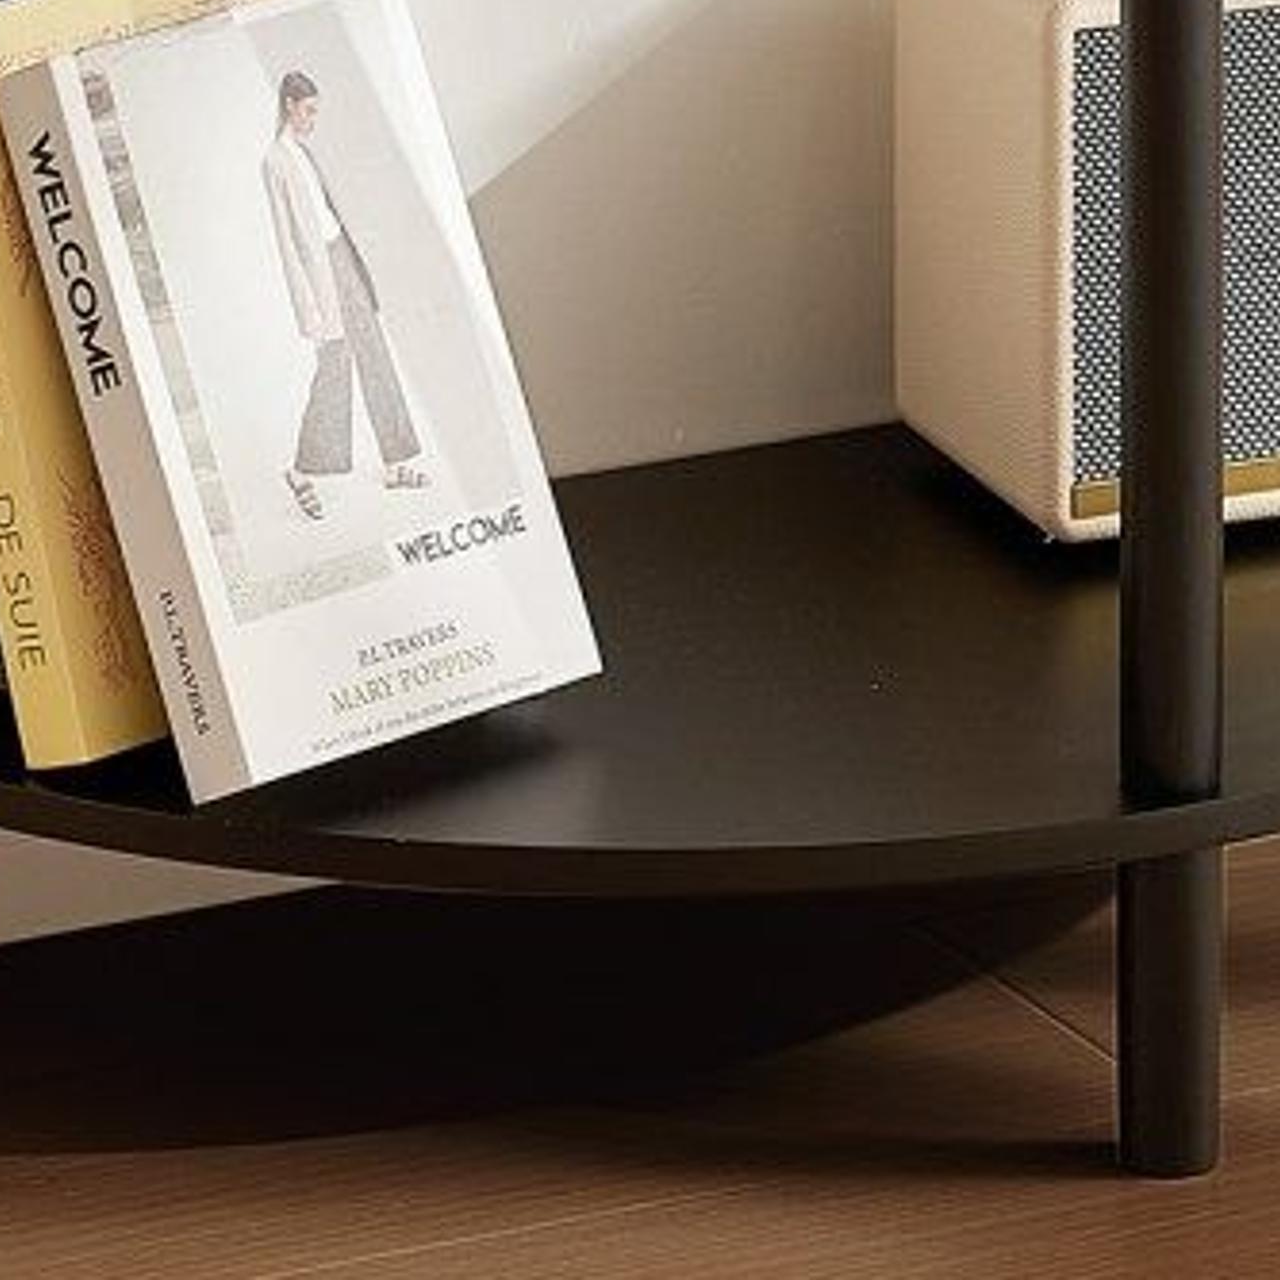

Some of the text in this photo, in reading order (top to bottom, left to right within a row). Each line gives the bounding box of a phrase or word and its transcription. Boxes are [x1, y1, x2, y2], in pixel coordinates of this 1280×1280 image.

[28, 130, 122, 397] WELCOME
[396, 503, 528, 565] WELCOME
[3, 571, 46, 671] SUIE
[329, 673, 396, 715] MARY
[397, 641, 496, 692] POPPINS
